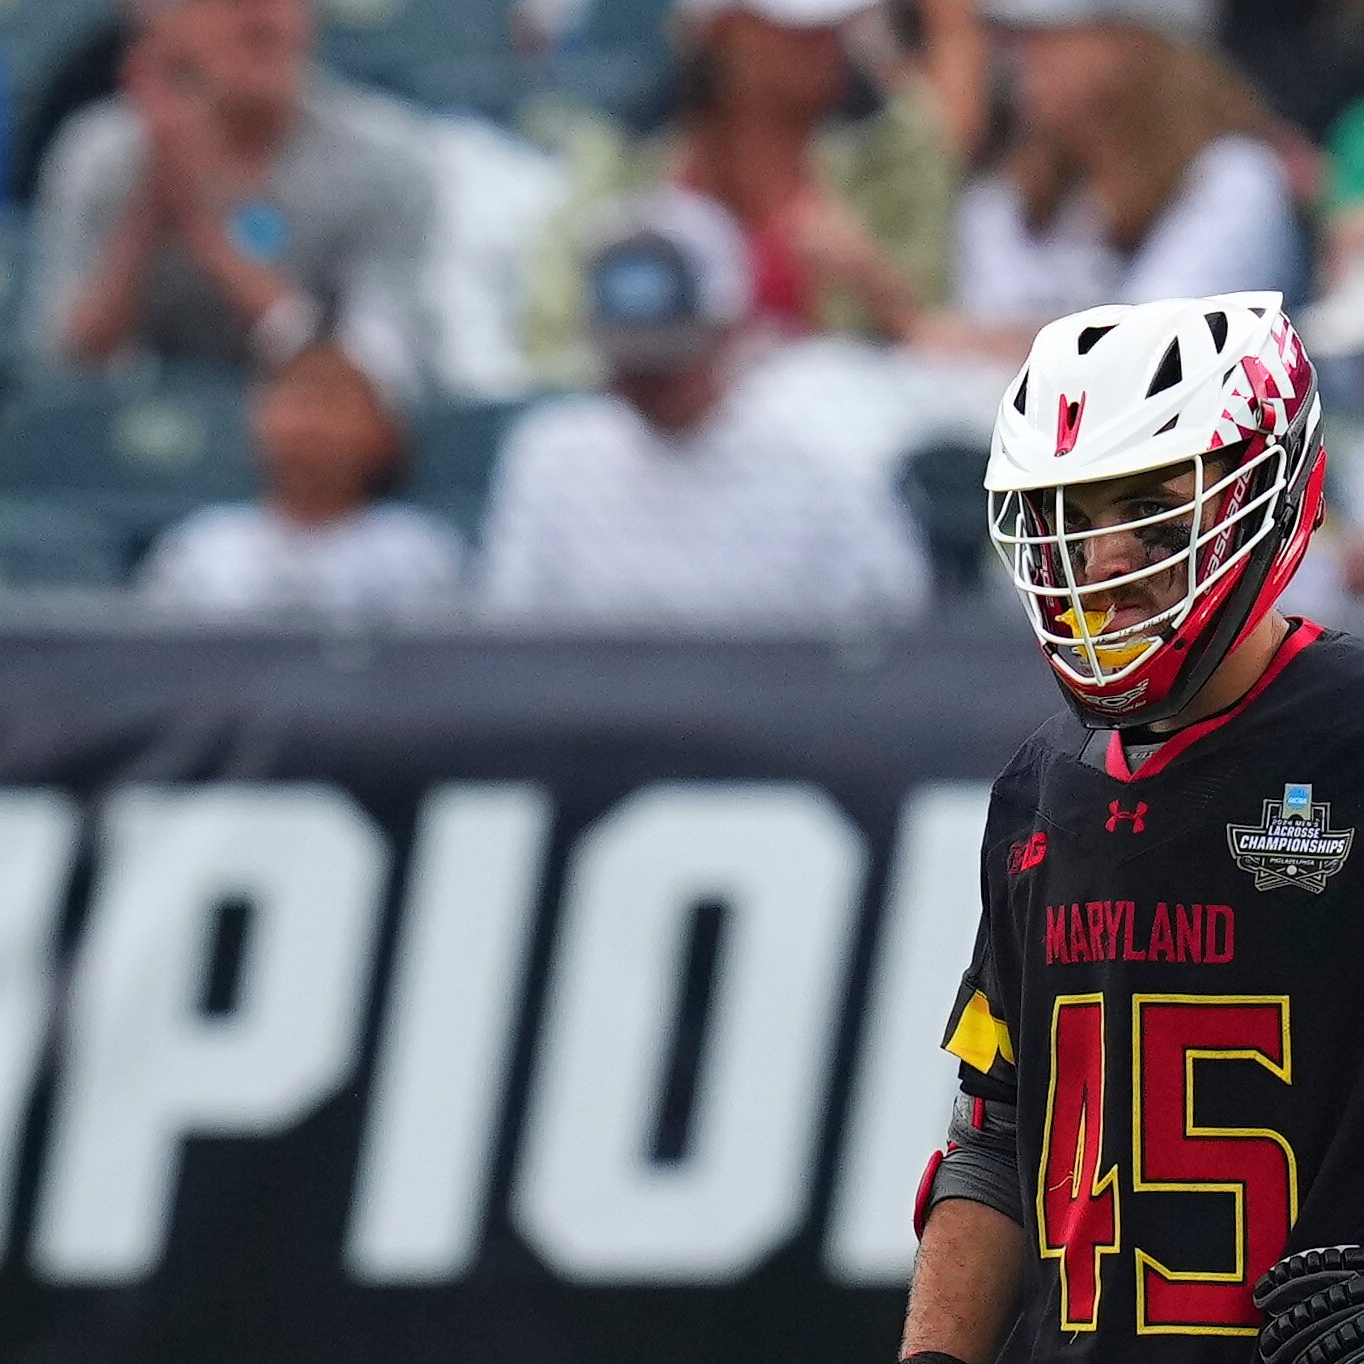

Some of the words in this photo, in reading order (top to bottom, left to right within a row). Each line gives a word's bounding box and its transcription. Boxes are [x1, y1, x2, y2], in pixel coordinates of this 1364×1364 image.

[1239, 835, 1346, 854] CHAMPIONSHIPS
[1268, 825, 1321, 839] LACROSSE
[1044, 901, 1234, 965] MARYLAND
[1036, 991, 1299, 1336] 45
